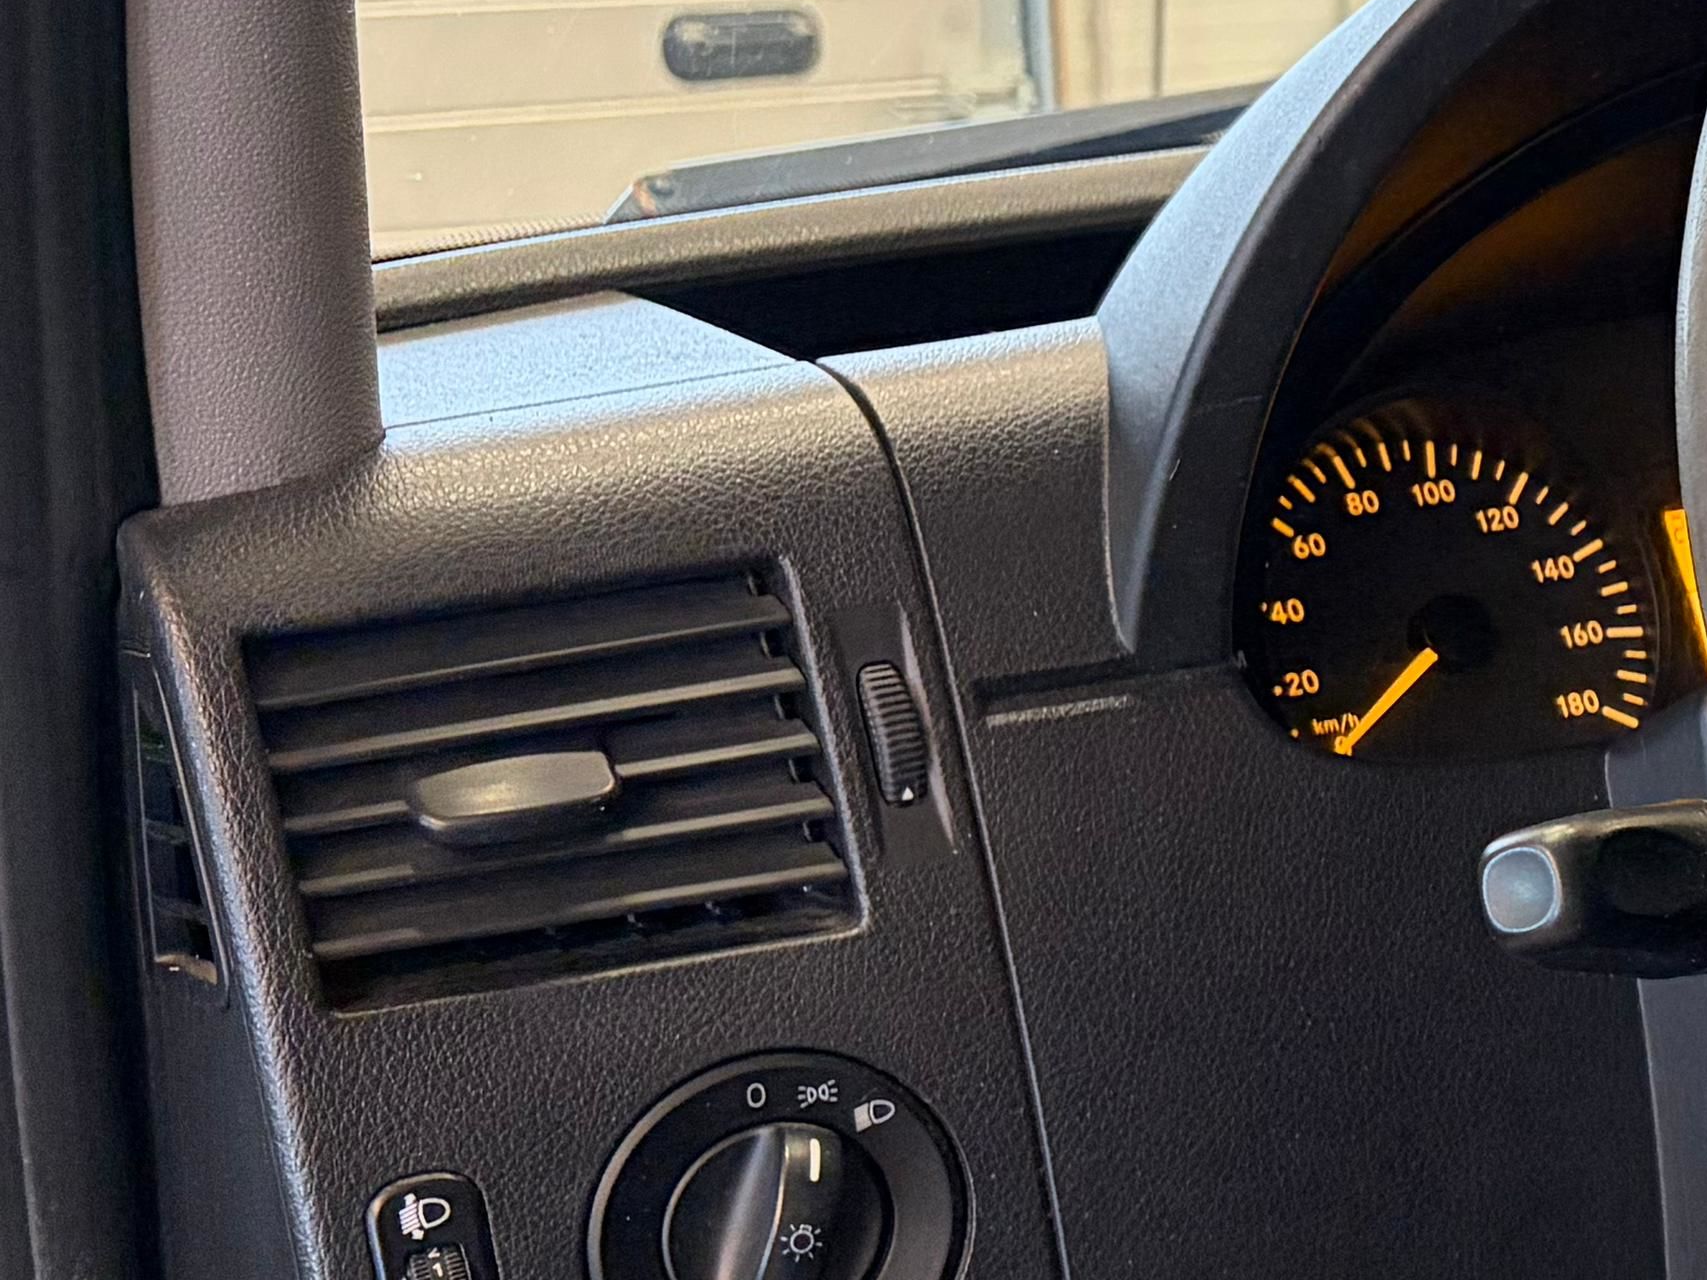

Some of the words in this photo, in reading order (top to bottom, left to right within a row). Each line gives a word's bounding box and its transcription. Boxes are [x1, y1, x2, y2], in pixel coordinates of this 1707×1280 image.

[1346, 490, 1380, 516] 80
[1411, 479, 1456, 507] 100
[1476, 505, 1519, 533] 120
[1293, 532, 1326, 559] 60
[1532, 555, 1575, 583] 140
[1271, 598, 1305, 624] 40
[1560, 620, 1603, 648] 160
[1284, 669, 1320, 697] 20
[1556, 689, 1600, 718] 180
[1312, 713, 1361, 736] km/h
[432, 1262, 443, 1277] 1
